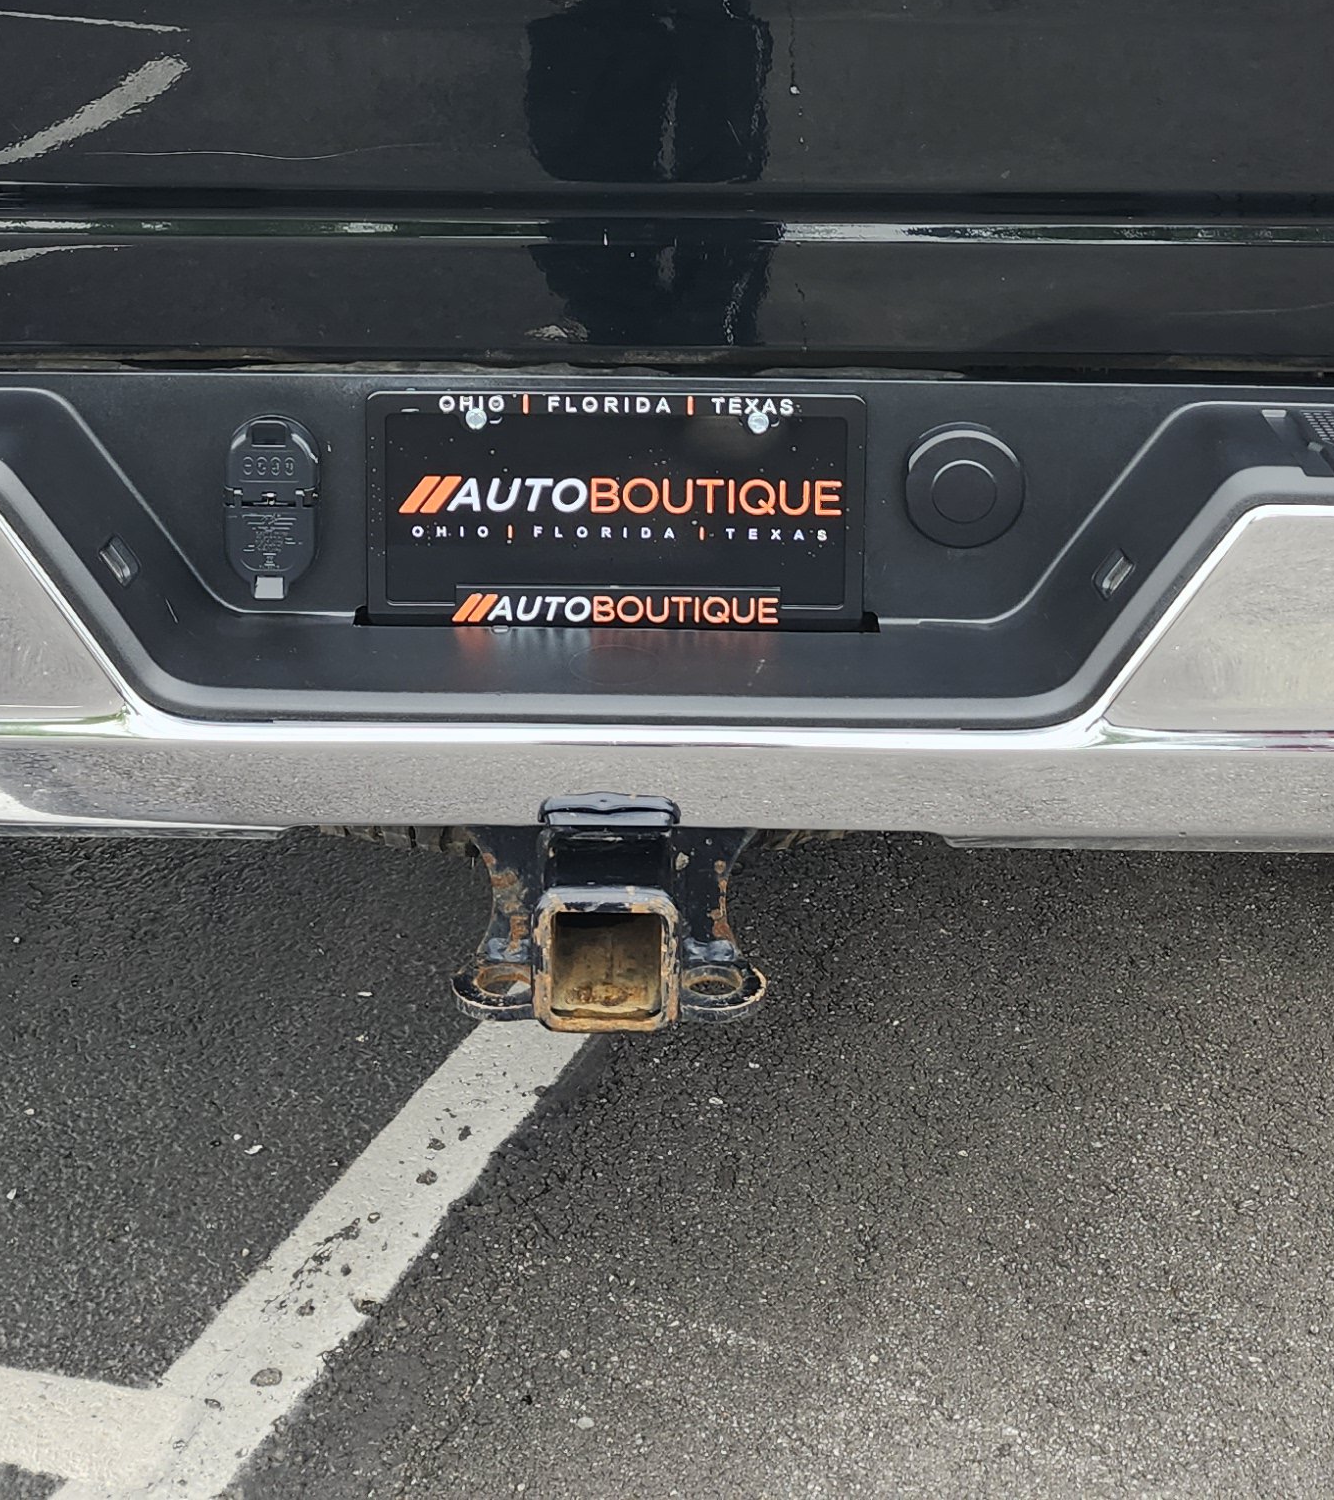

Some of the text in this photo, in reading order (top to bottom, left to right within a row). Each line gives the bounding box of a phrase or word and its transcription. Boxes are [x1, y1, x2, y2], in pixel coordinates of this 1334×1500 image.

[438, 395, 794, 415] OHIO FLORIDA TEXAS
[447, 476, 843, 516] AUTOBOUTIQUE
[411, 525, 829, 541] OHIO FLORIDA TEXAS
[489, 594, 780, 624] AUTOBOUTIQUE
